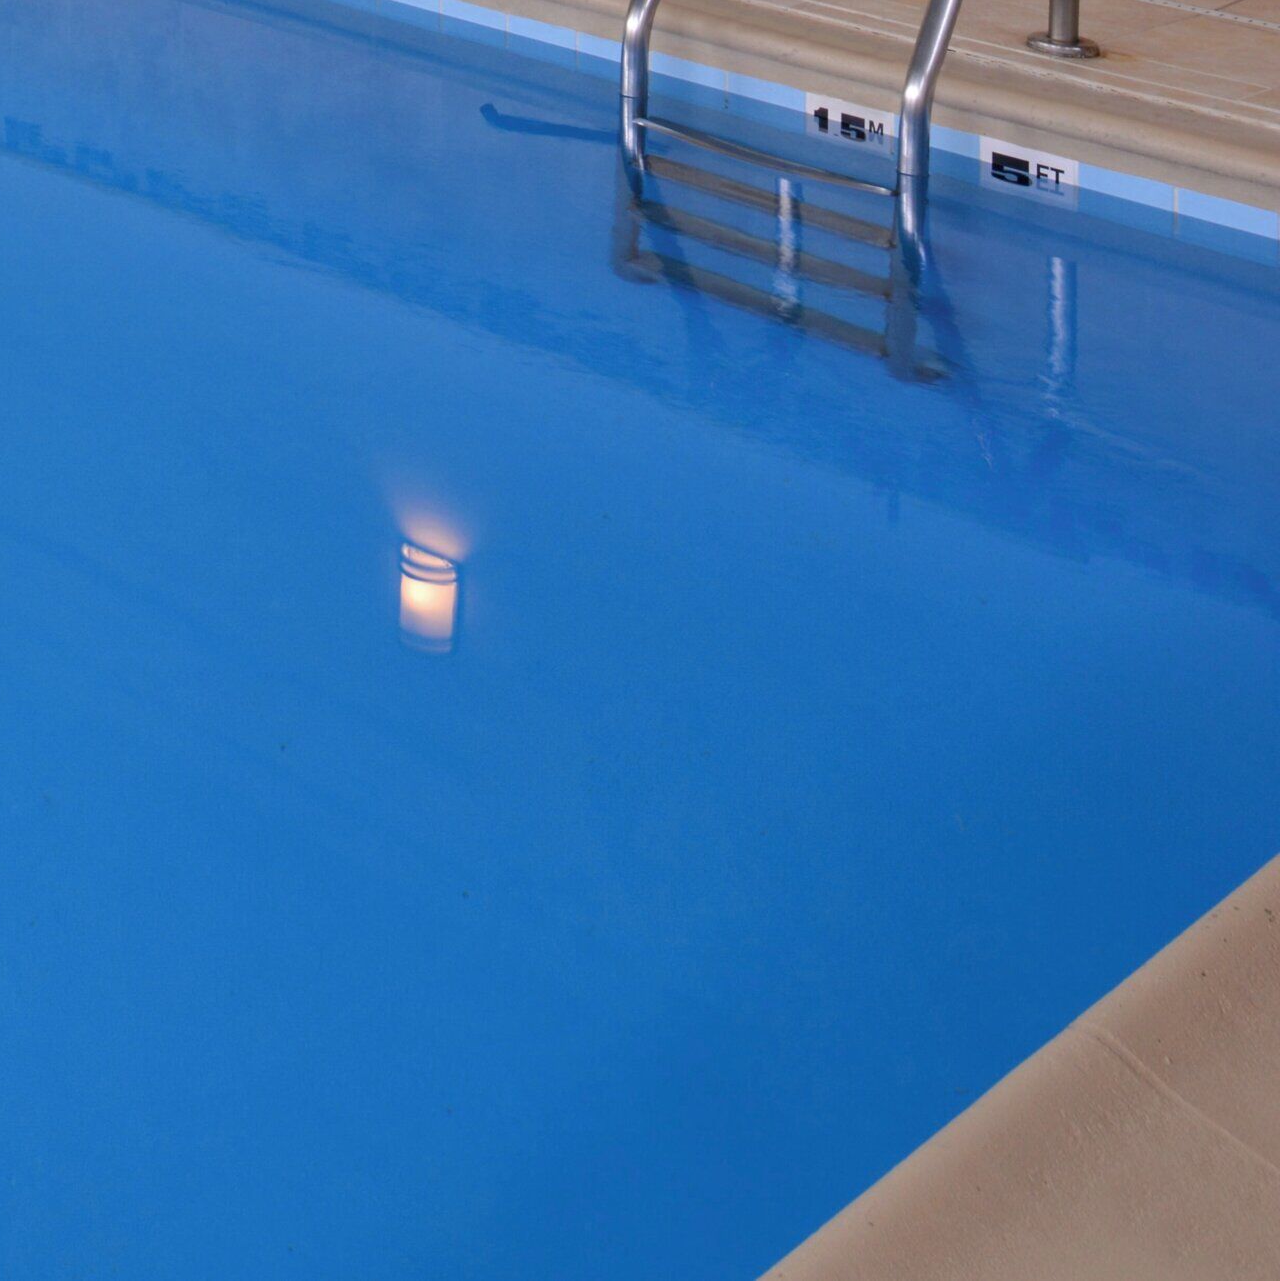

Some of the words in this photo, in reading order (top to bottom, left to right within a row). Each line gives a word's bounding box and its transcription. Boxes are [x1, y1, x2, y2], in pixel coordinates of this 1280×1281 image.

[868, 120, 884, 136] M
[991, 151, 1032, 187] 5
[1036, 163, 1065, 185] FT
